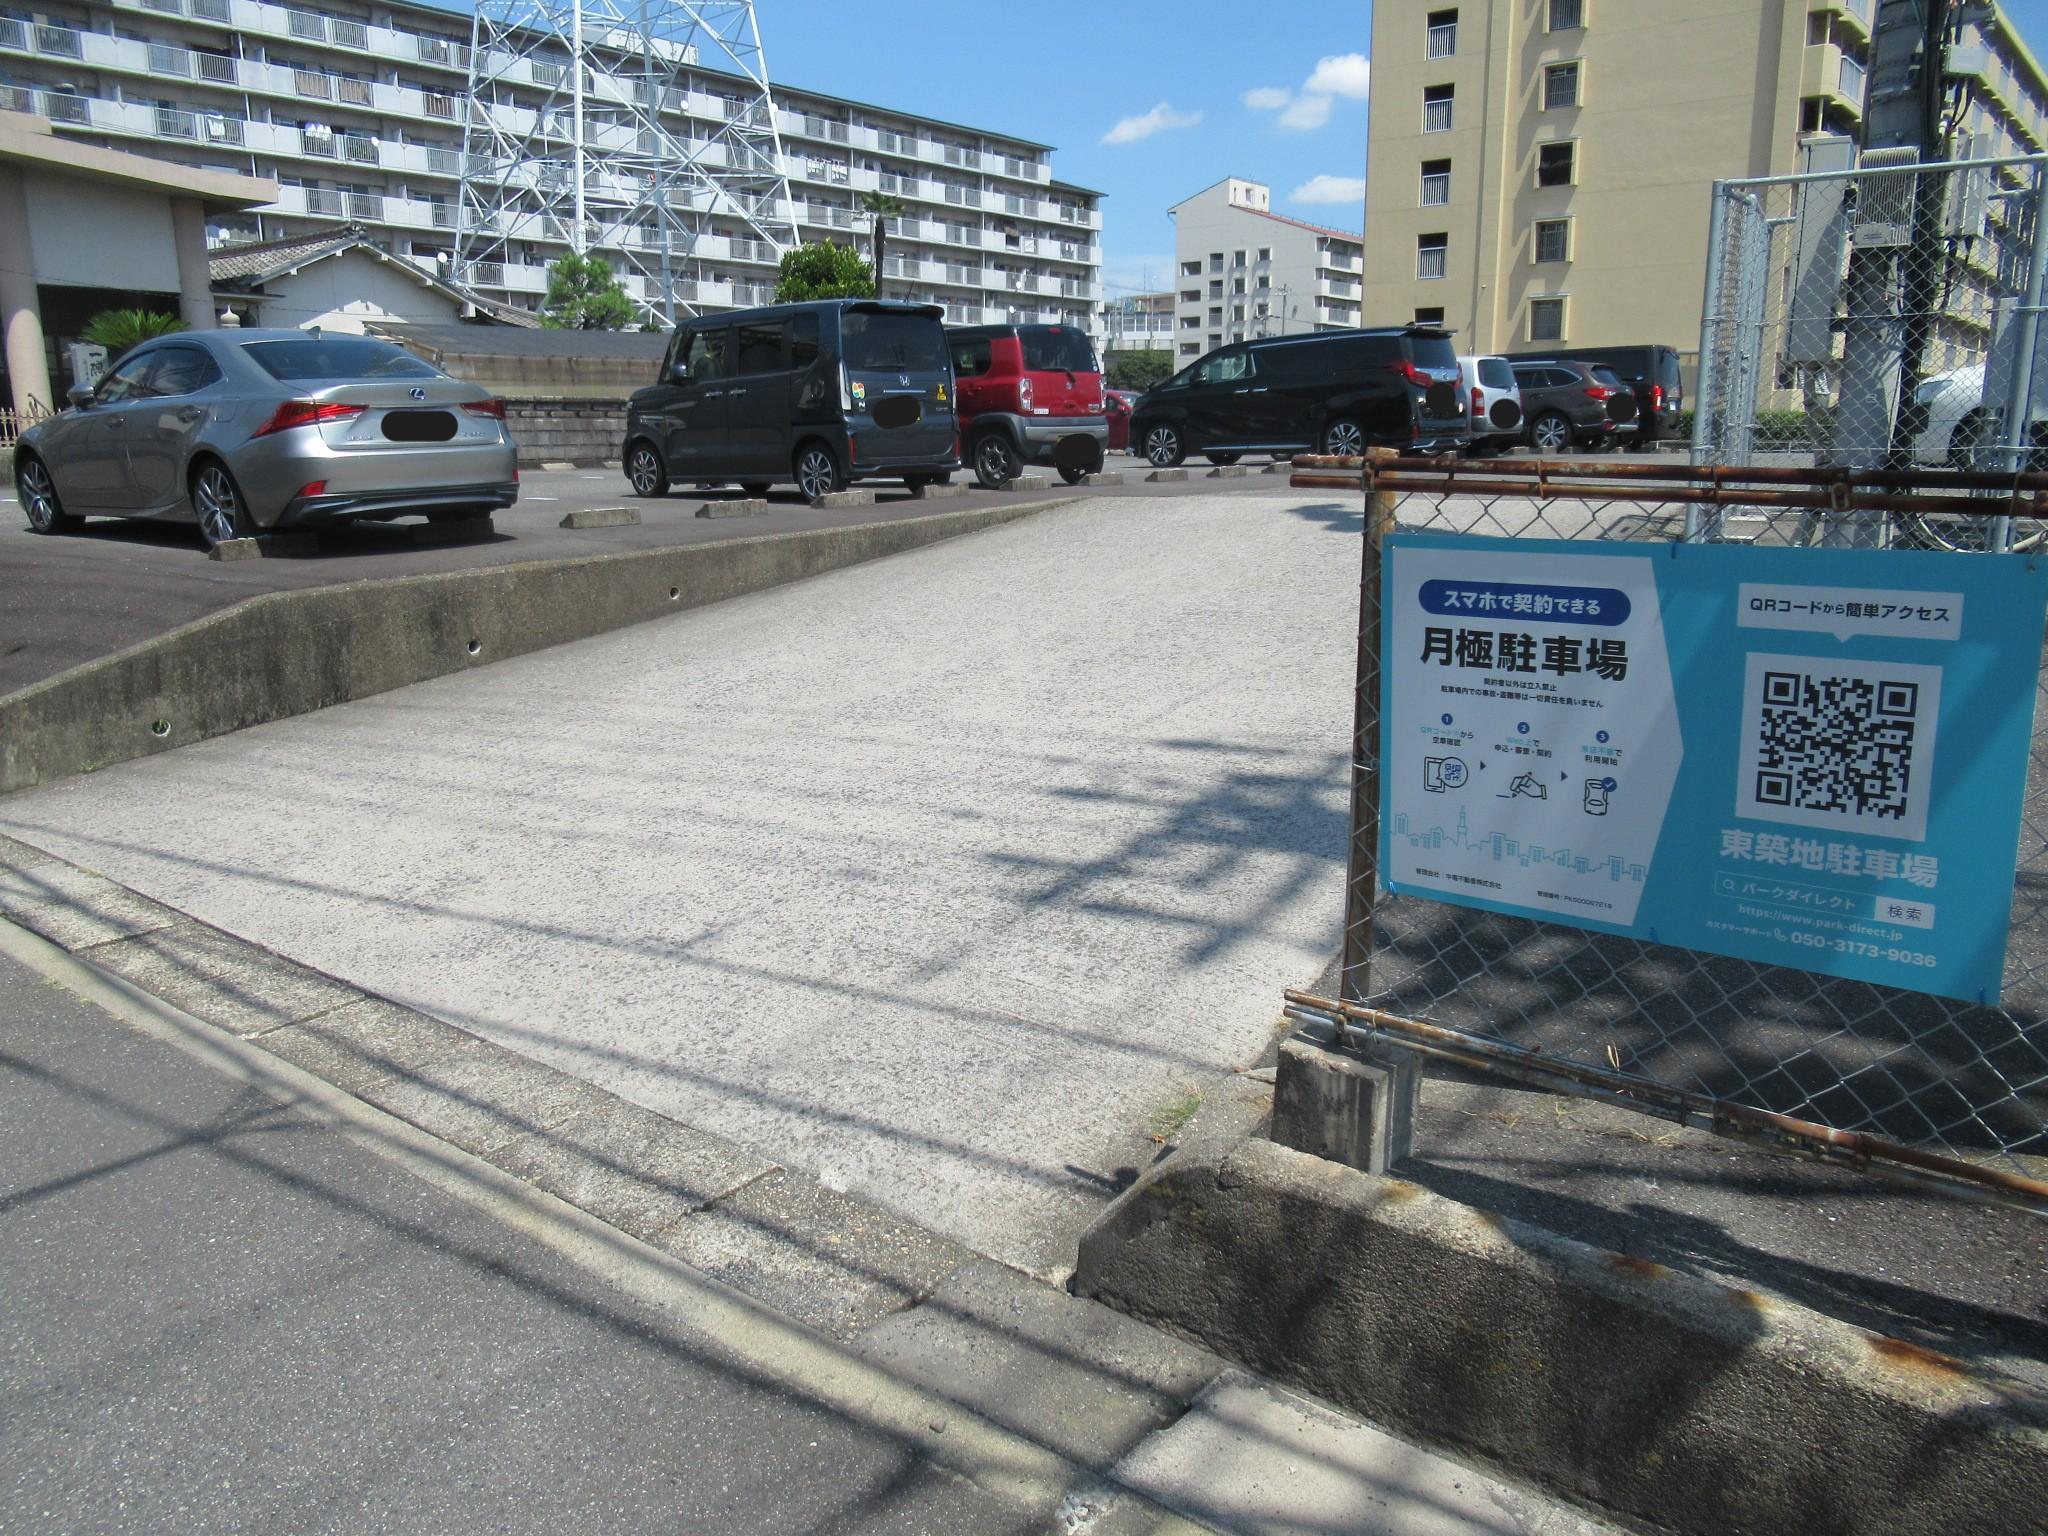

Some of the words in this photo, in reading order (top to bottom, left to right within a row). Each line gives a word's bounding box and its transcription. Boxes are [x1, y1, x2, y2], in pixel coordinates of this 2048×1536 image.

[1444, 590, 1601, 616] スマホで契約できる
[1750, 597, 1950, 623] QRコードから簡単アクセス
[1420, 626, 1629, 682] 月極駐車場
[1483, 677, 1557, 692] 契約者以外は立入禁止
[1585, 755, 1618, 767] 利用開始
[1719, 828, 1939, 889] 東築地駐車場
[1741, 882, 1856, 910] パークダイレクト
[1887, 904, 1922, 922] 検索
[1738, 904, 1904, 941] https://www.park-direct.jp
[1791, 931, 1937, 968] 050-3173-9036
